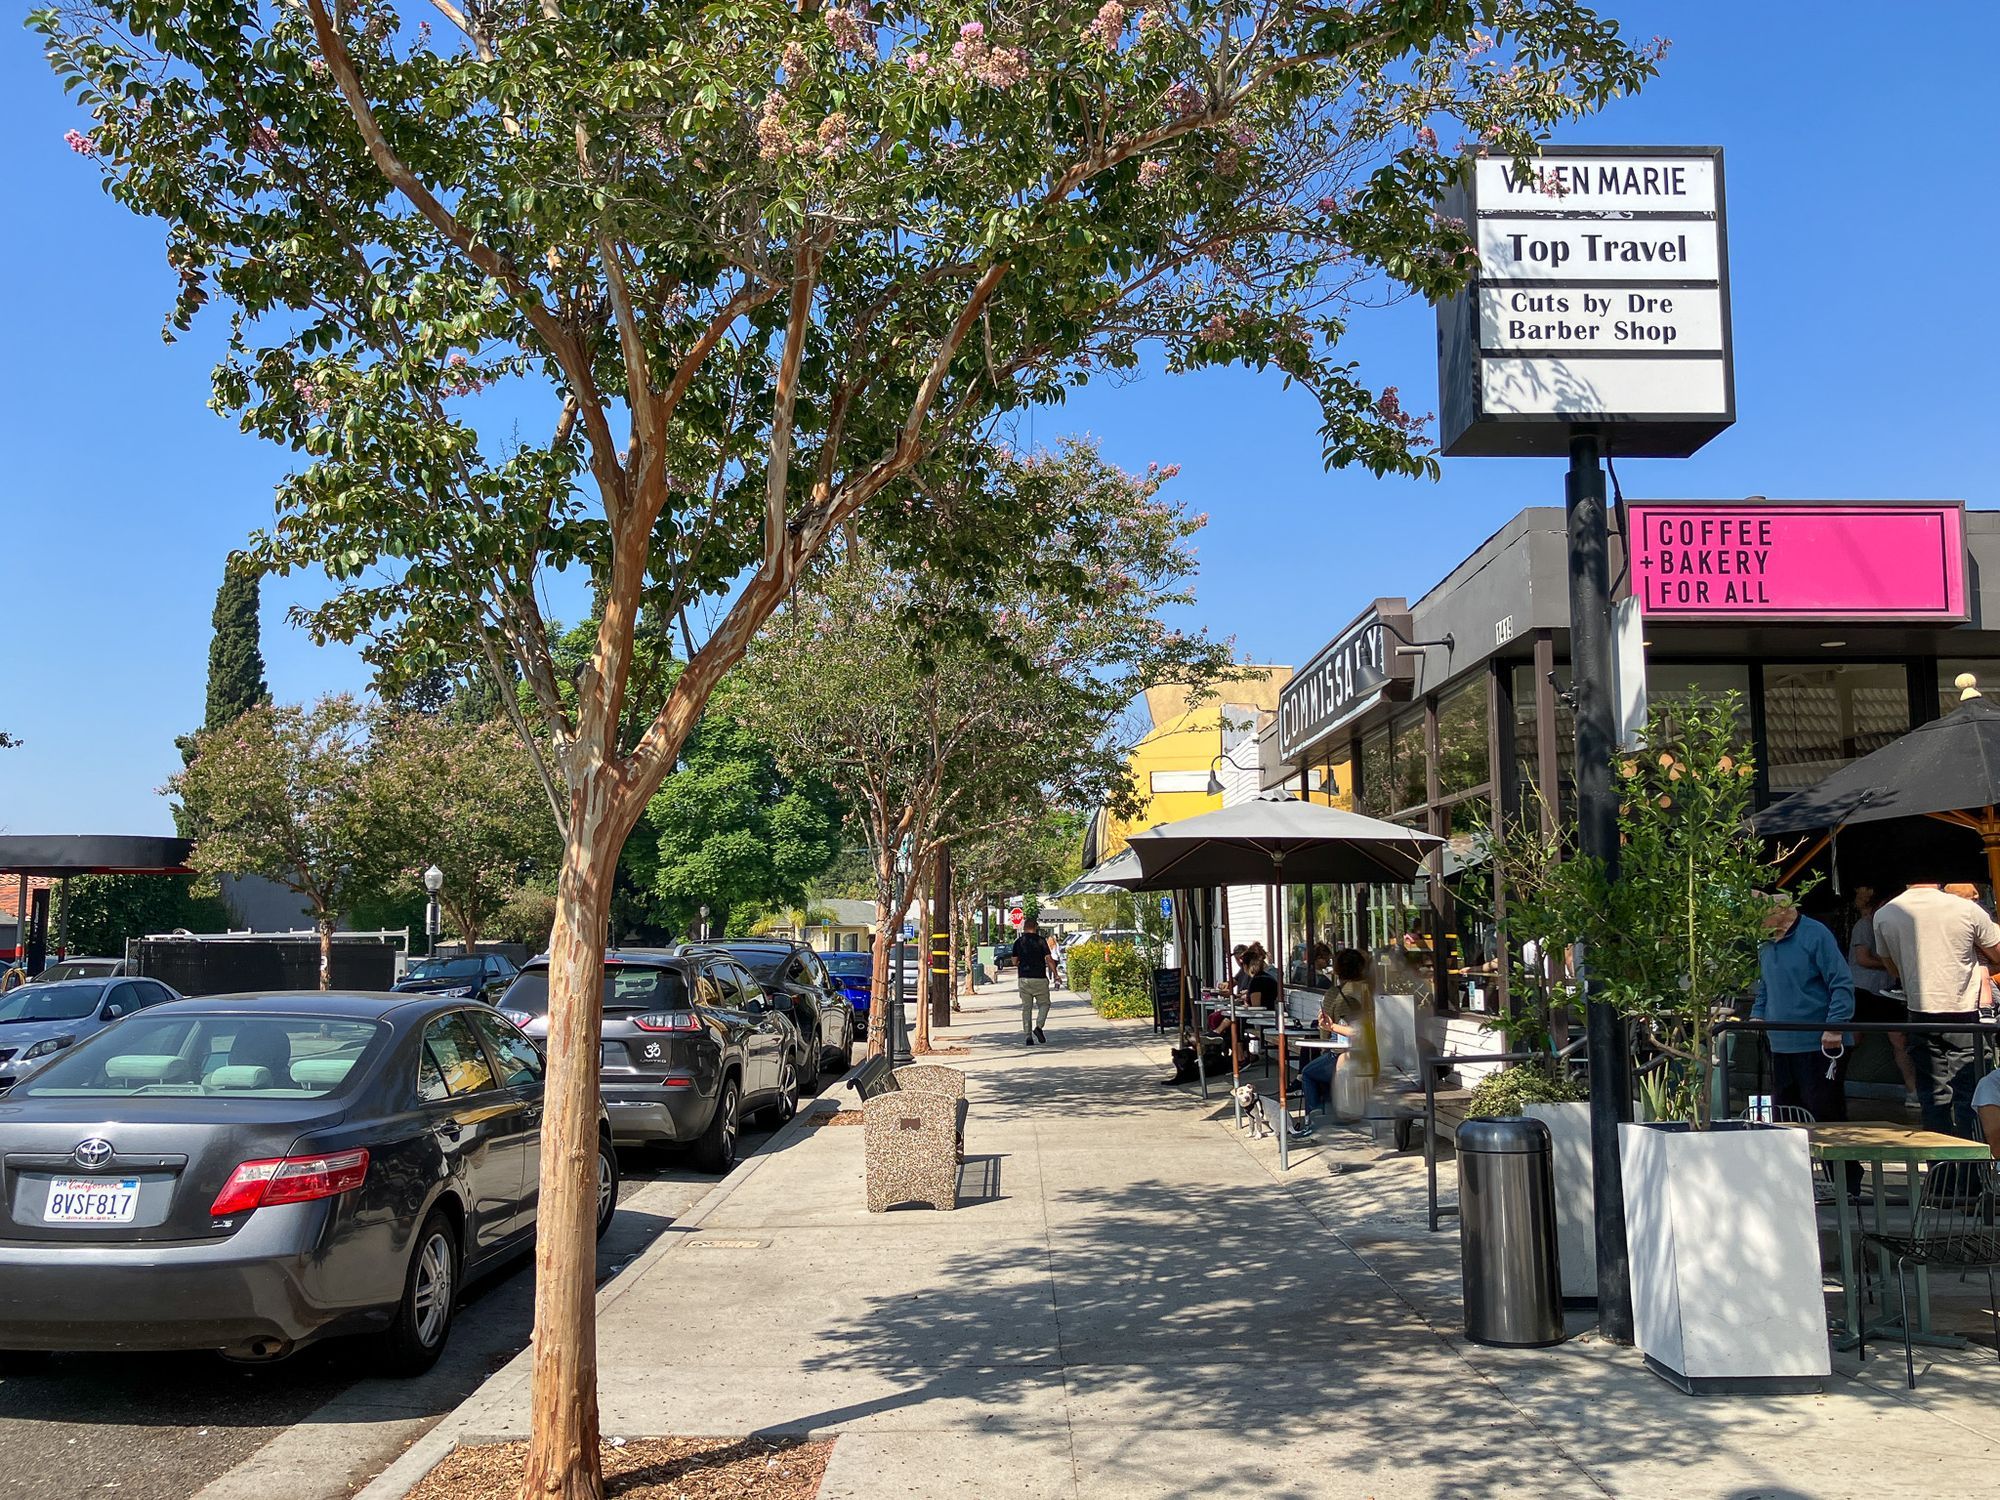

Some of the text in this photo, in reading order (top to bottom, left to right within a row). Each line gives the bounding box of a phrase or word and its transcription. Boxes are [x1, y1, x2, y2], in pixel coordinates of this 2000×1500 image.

[1598, 166, 1687, 195] MARIE
[1507, 234, 1687, 268] Top Travel
[1511, 293, 1673, 317] Cuts by Dre
[1509, 320, 1677, 344] Barber Shop
[1660, 520, 1772, 546] COFFEE
[1660, 550, 1768, 574] BAKERY
[1661, 581, 1770, 604] FOR ALL
[1496, 616, 1512, 644] 1419
[51, 1193, 132, 1215] 8VSF817
